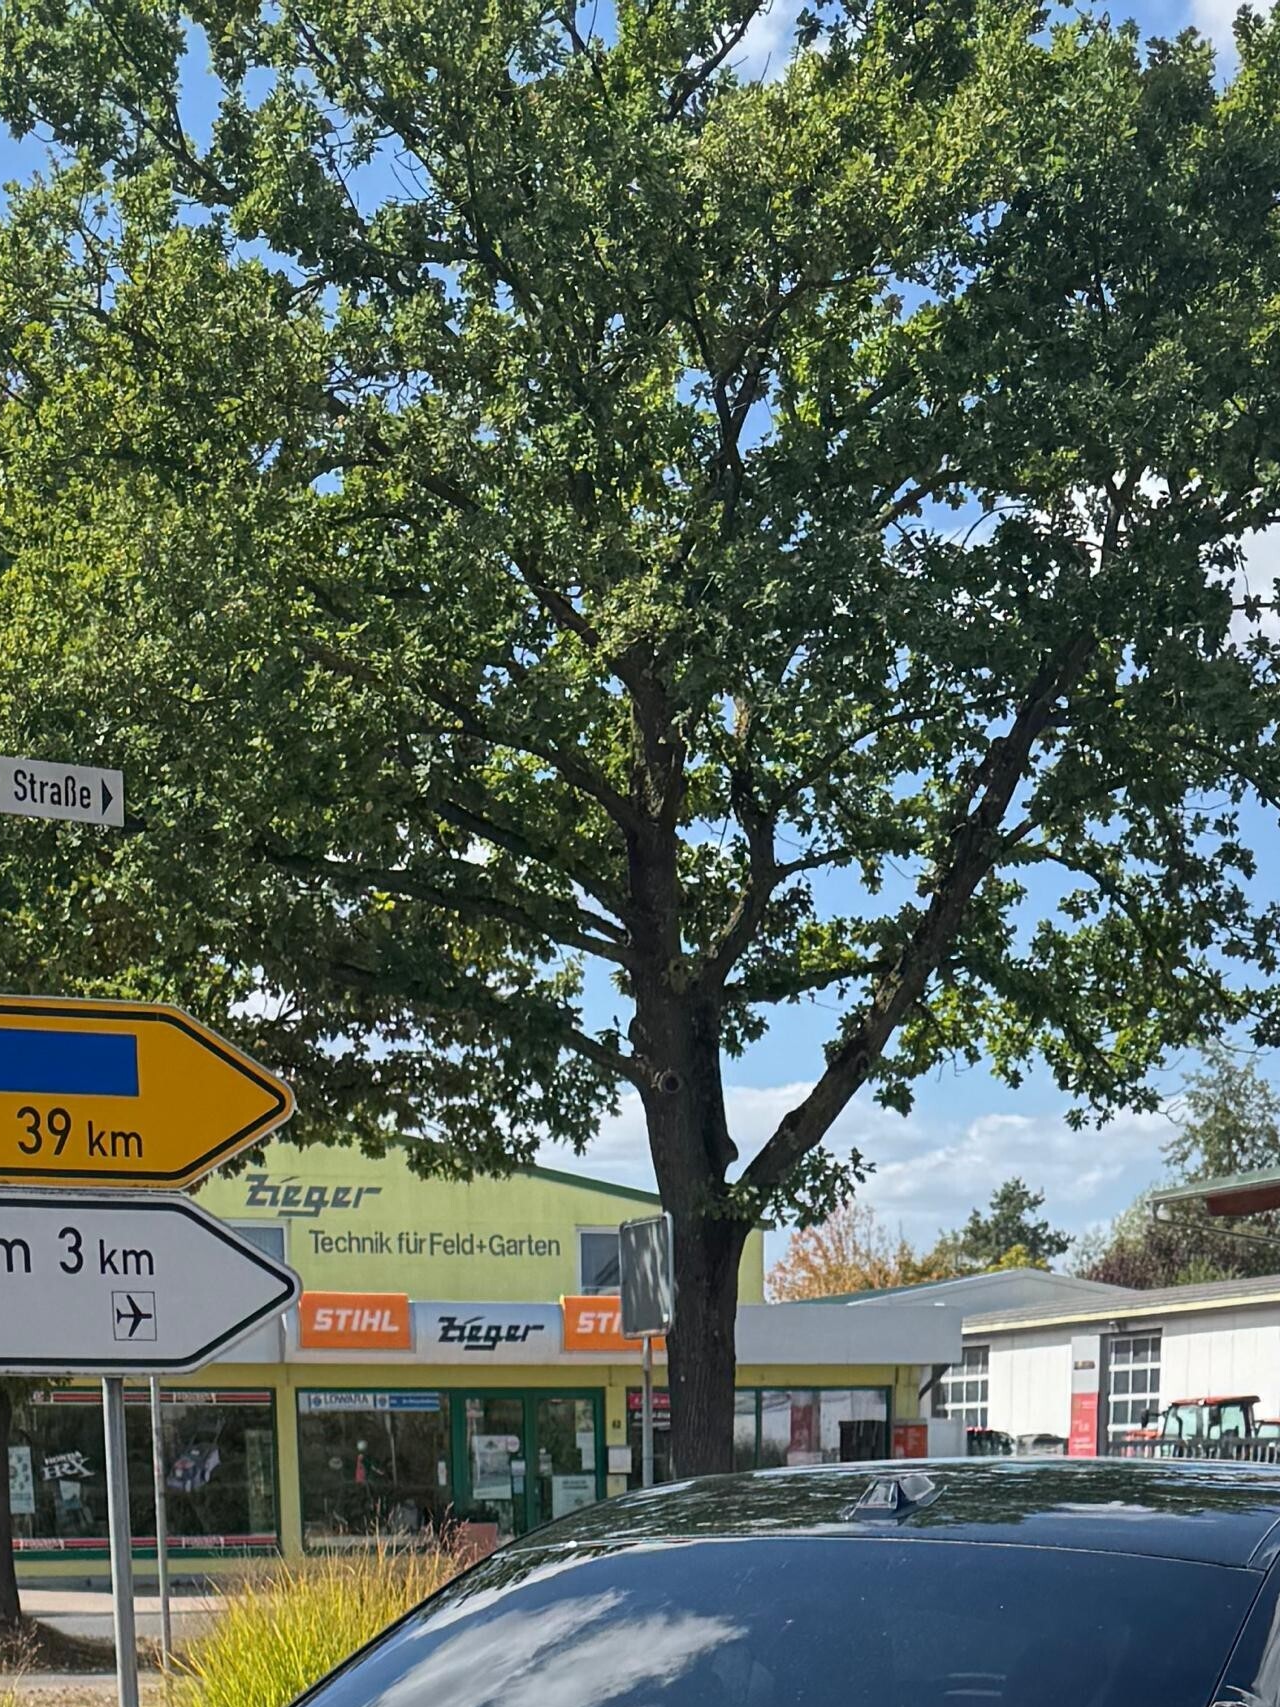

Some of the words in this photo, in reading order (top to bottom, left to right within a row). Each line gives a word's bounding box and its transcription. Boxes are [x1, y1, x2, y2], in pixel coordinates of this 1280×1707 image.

[14, 769, 91, 809] Straße
[16, 1106, 73, 1158] 39
[87, 1119, 145, 1159] km
[58, 1226, 85, 1276] 3
[99, 1239, 155, 1277] km
[308, 1229, 391, 1256] Technik
[398, 1230, 426, 1256] für
[428, 1230, 561, 1258] Feld+Garten
[313, 1308, 400, 1333] STIHL
[576, 1310, 621, 1335] STI
